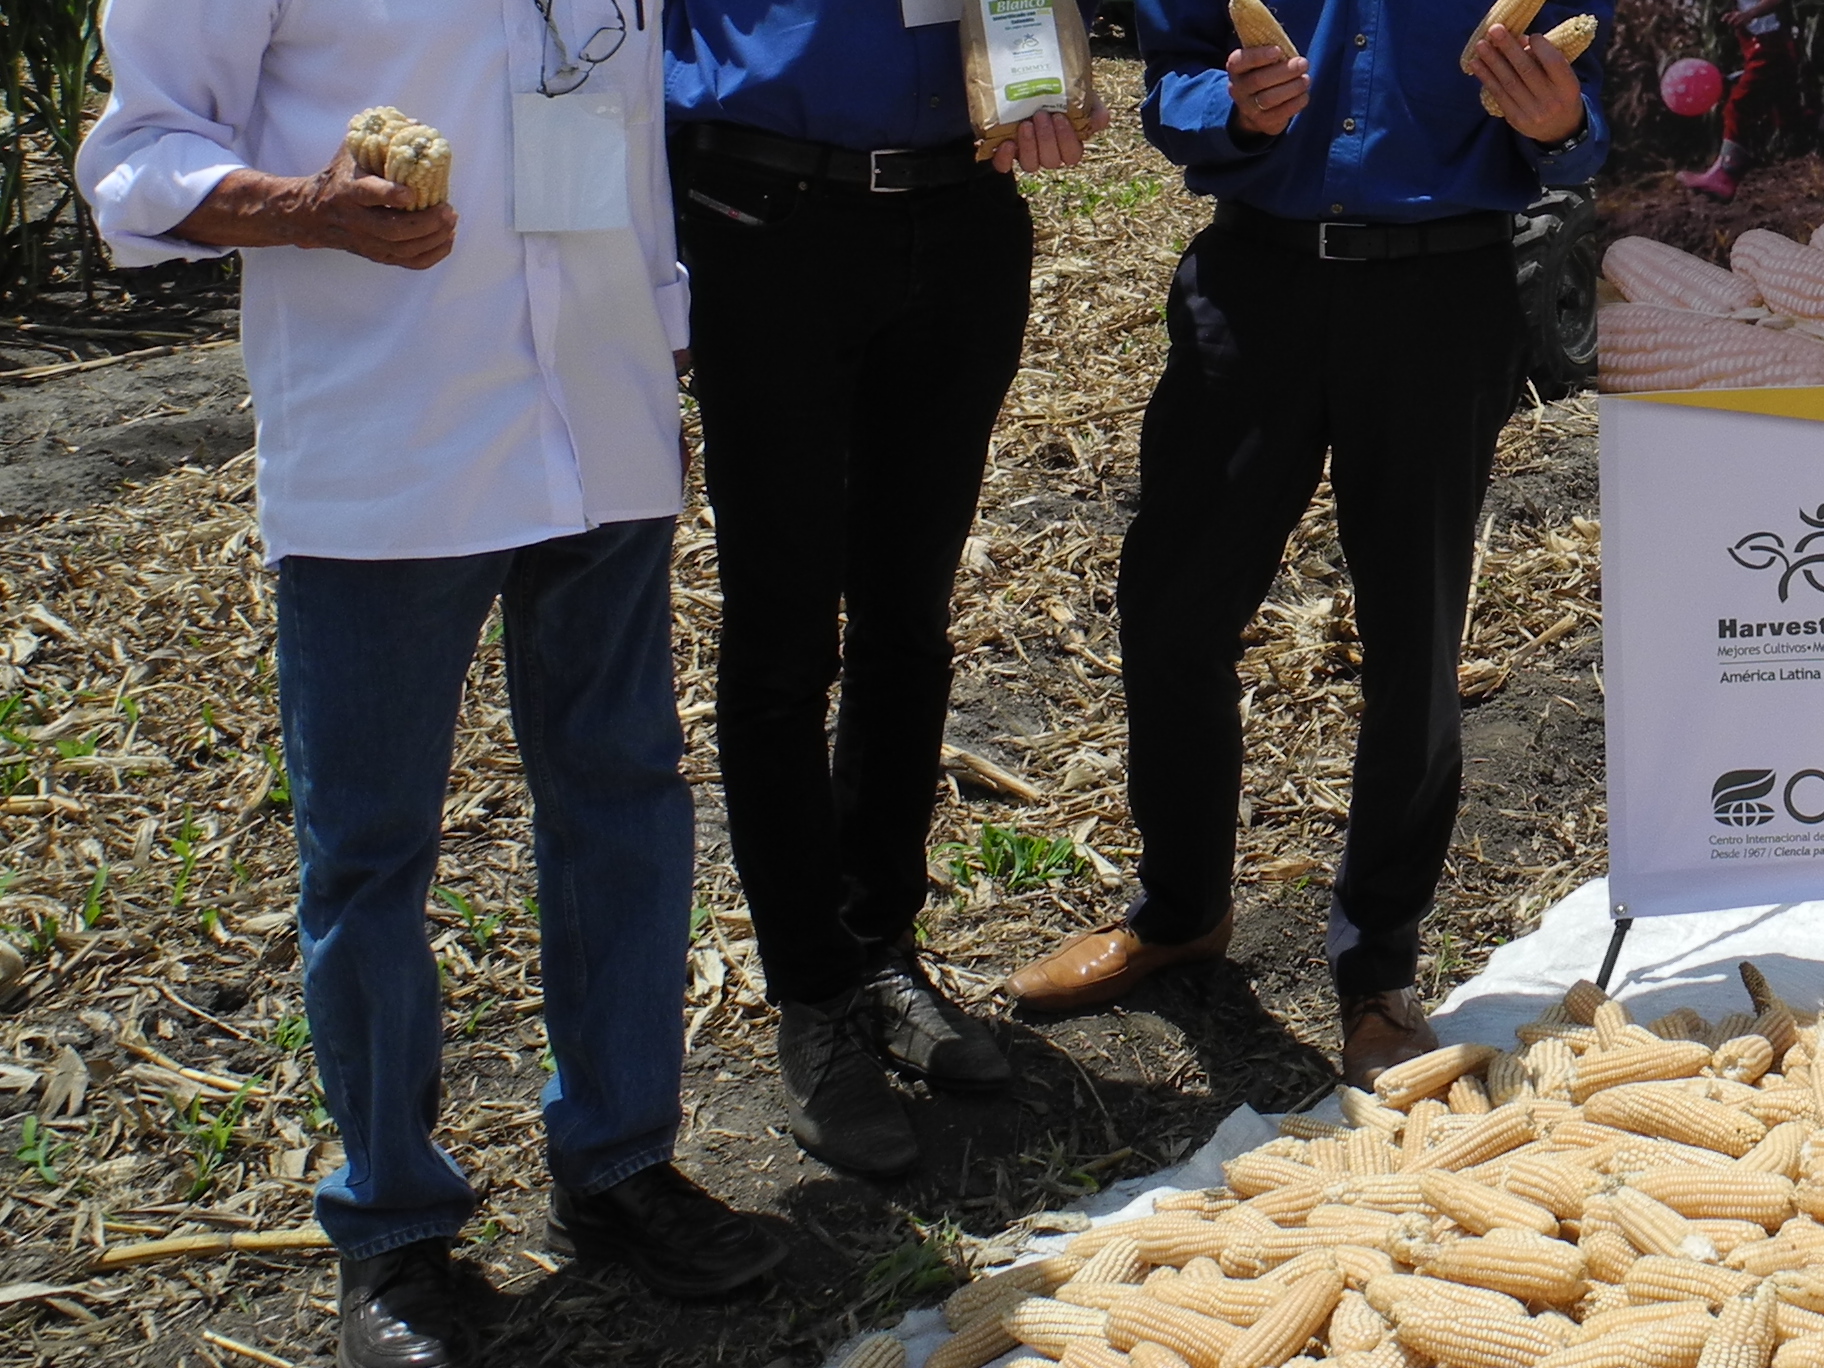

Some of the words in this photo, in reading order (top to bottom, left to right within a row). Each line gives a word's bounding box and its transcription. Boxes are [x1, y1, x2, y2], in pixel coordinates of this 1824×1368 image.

[1718, 645, 1760, 658] Mejores
[1720, 670, 1775, 683] América
[1780, 667, 1821, 681] Latina
[1709, 835, 1744, 845] Centro
[1746, 832, 1810, 844] Internacional
[1711, 849, 1740, 860] Desde
[1743, 848, 1766, 859] 1967
[1774, 846, 1810, 857] Ciencia
